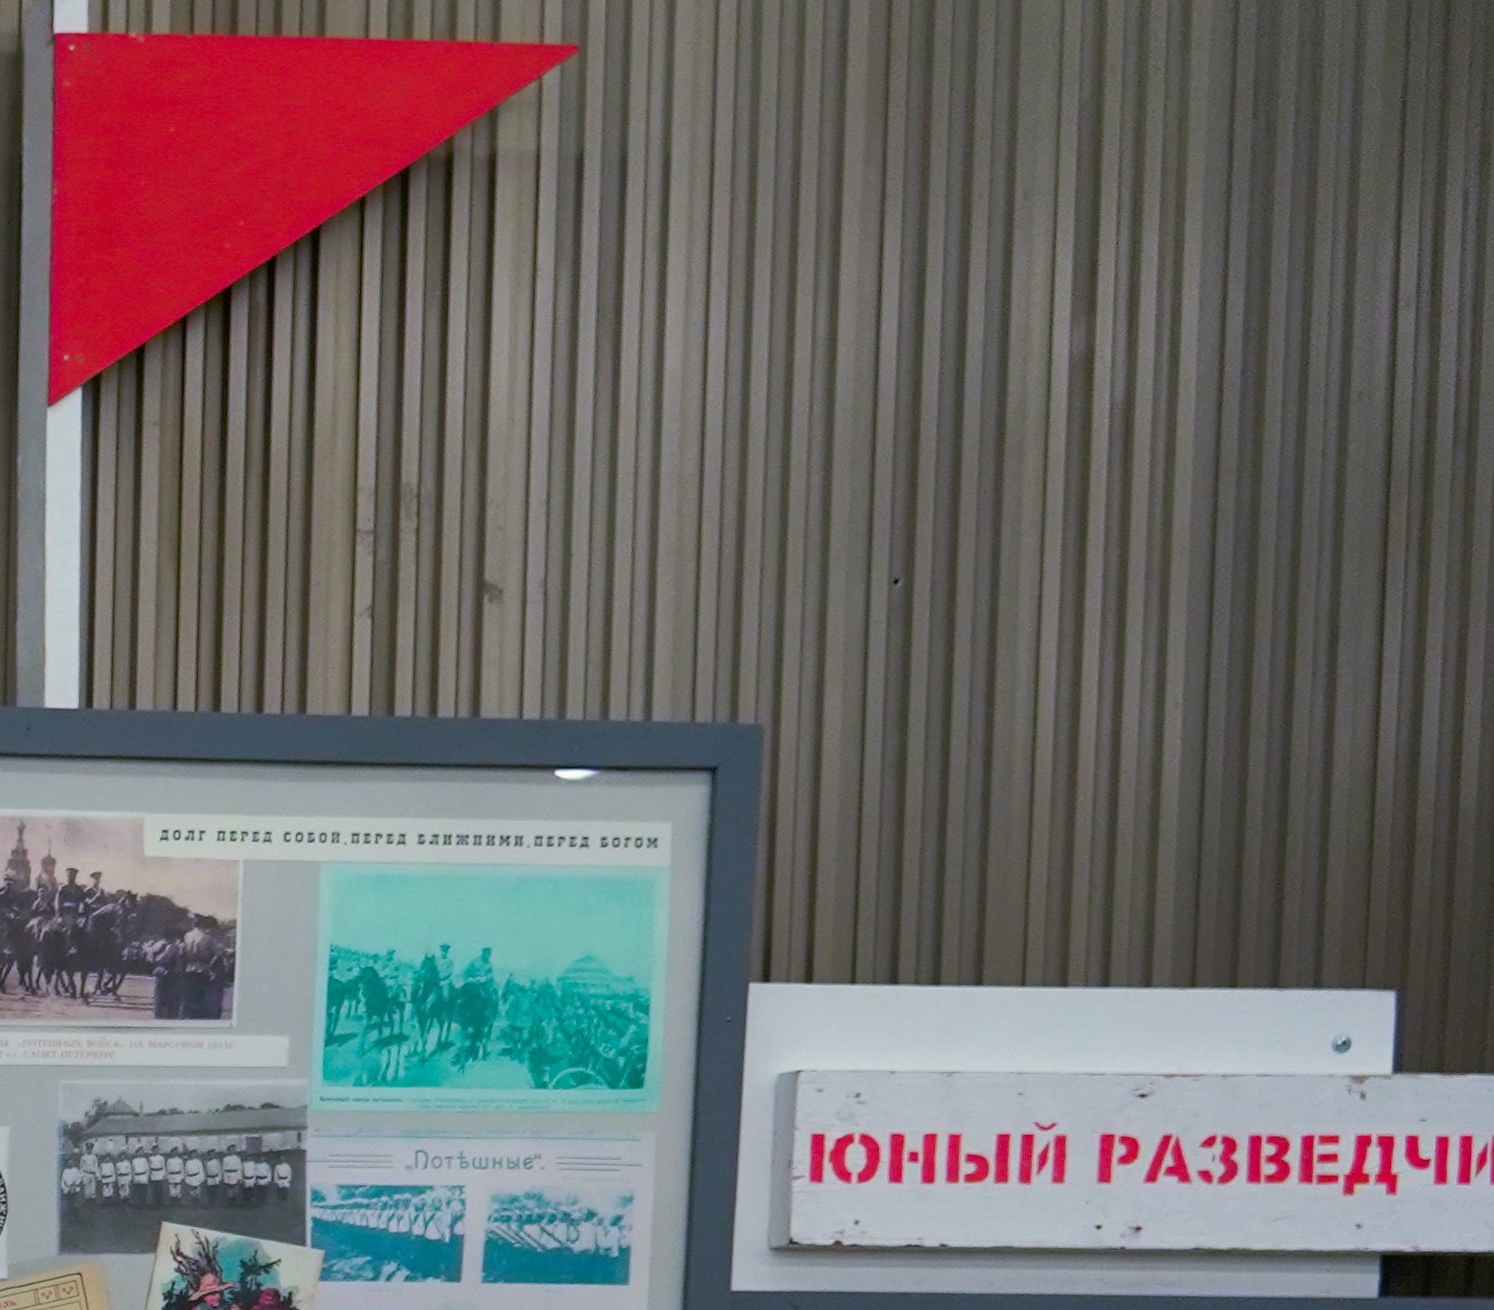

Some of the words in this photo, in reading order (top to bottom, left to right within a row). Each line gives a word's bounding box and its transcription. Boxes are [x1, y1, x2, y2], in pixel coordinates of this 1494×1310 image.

[160, 829, 206, 842] ДОЛГ
[217, 830, 272, 843] ПЕРЕД
[600, 837, 658, 849] БОГОМ
[809, 1122, 1067, 1184] ЮНЫЙ
